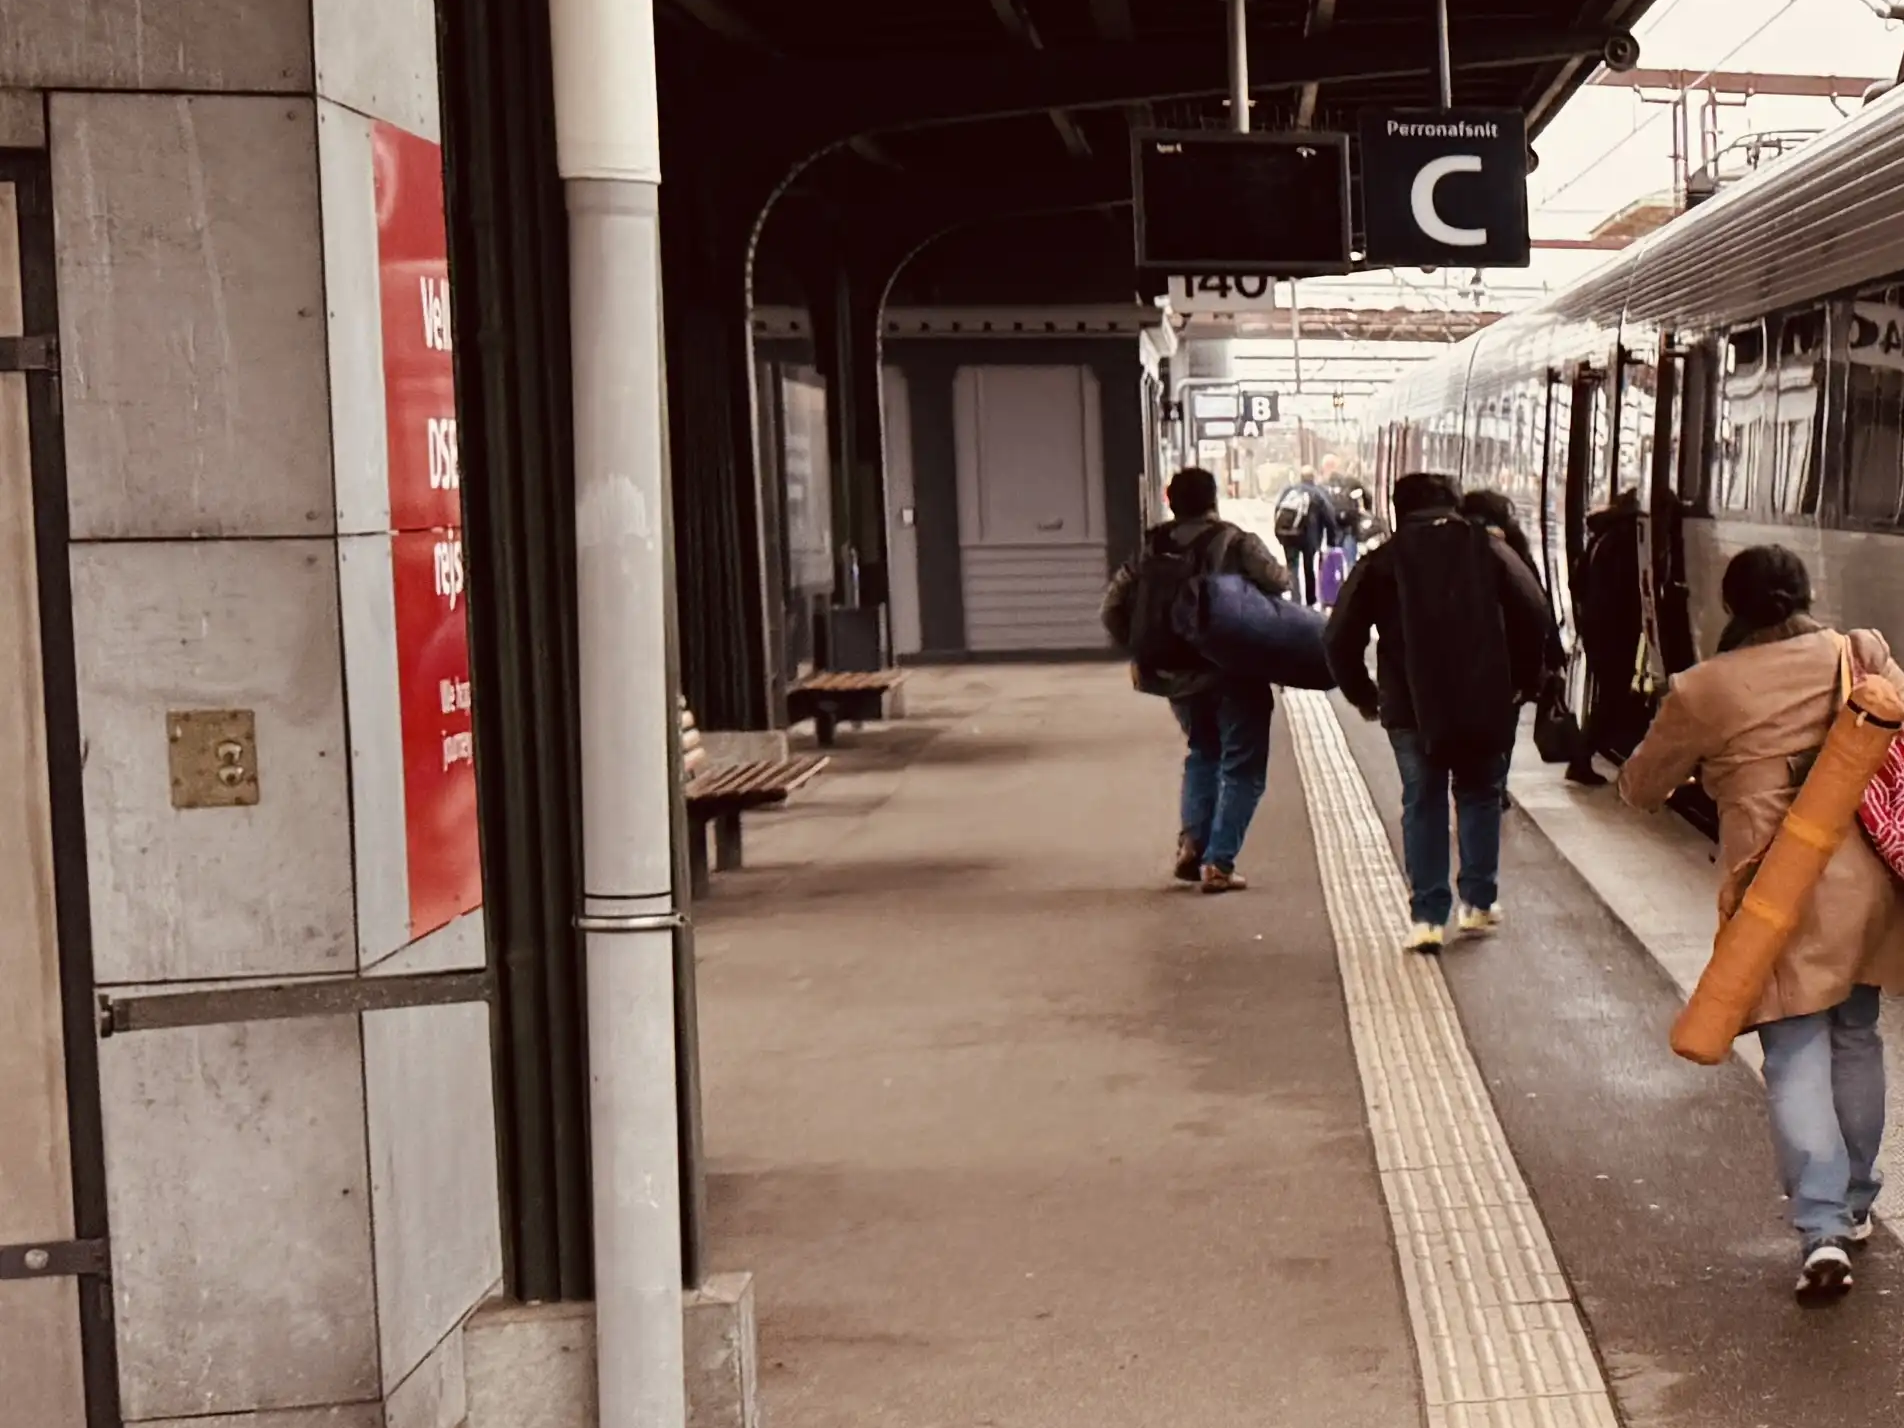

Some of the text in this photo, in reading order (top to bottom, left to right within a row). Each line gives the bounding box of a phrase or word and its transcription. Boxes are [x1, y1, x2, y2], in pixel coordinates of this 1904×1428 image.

[1387, 120, 1499, 138] Perronafsnit
[1410, 155, 1487, 246] C
[1251, 396, 1272, 421] B
[1243, 420, 1260, 437] A
